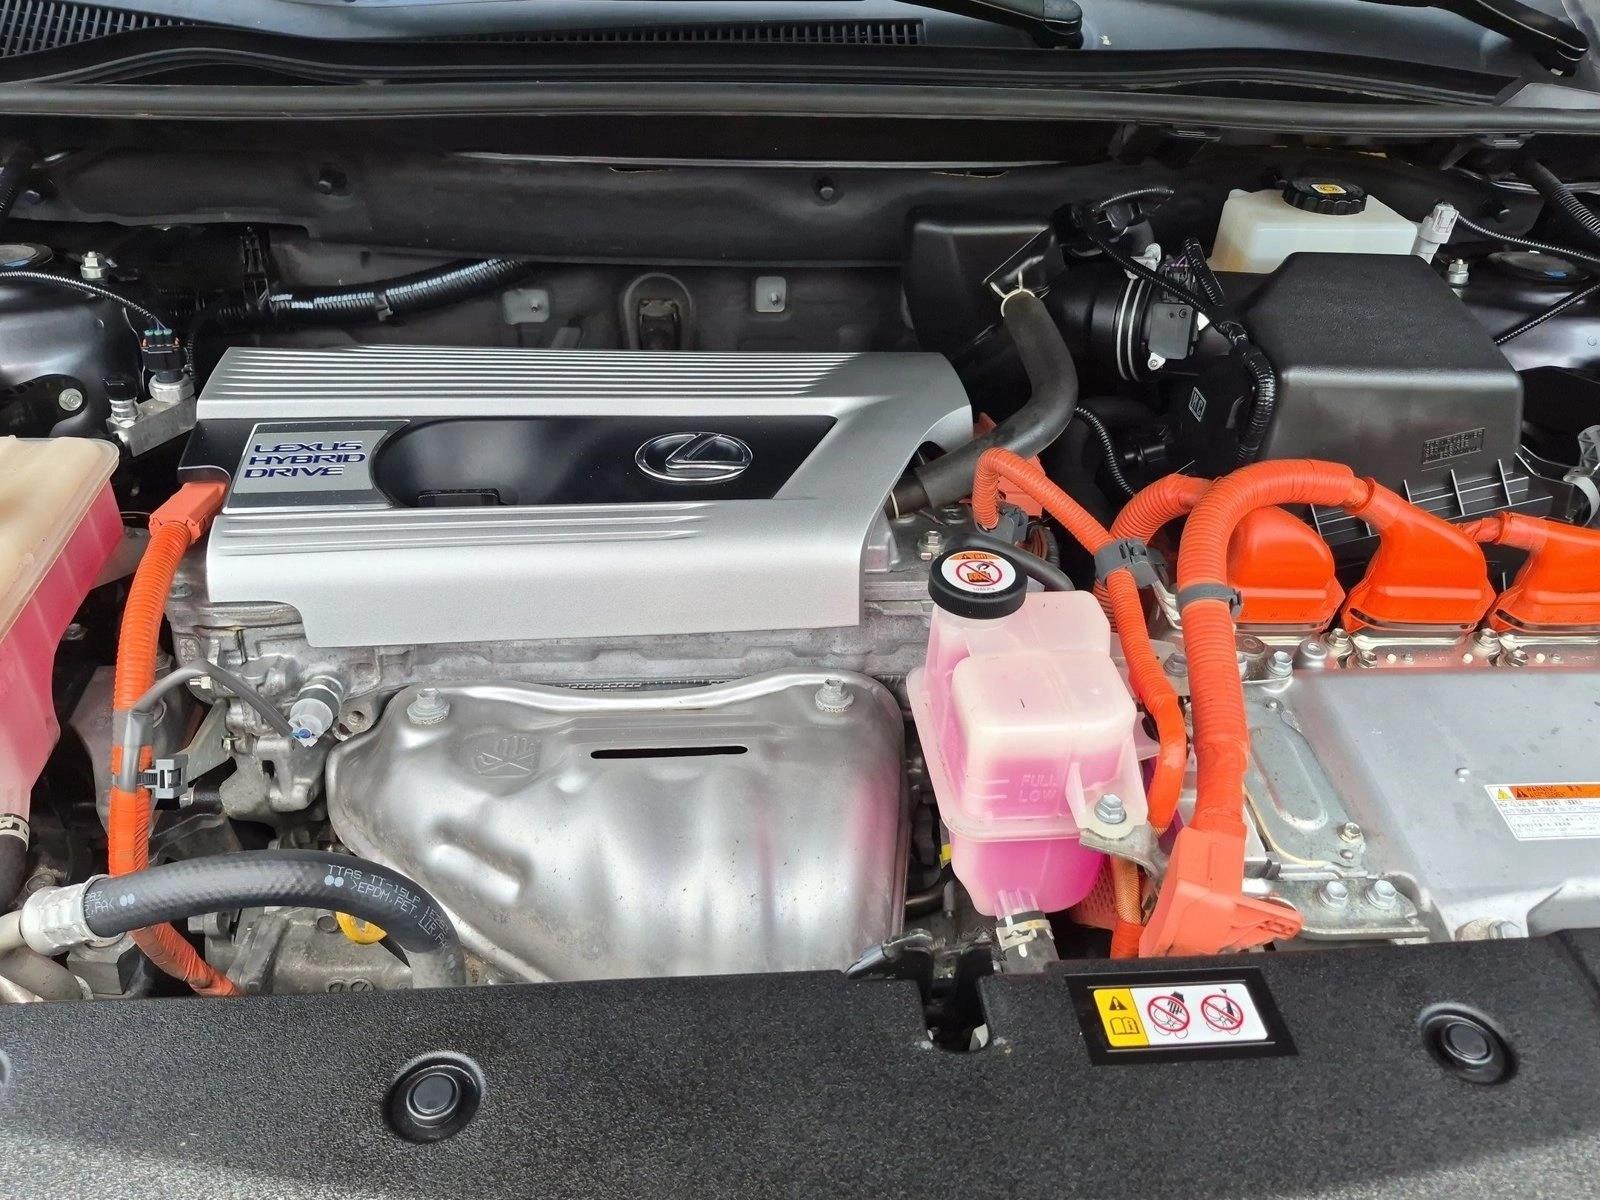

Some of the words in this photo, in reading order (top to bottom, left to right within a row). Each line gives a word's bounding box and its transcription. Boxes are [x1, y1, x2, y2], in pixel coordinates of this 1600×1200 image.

[254, 441, 363, 453] LEXUS
[249, 453, 366, 466] HYBRID
[244, 465, 345, 478] DRIVE
[1020, 774, 1057, 788] FULL
[1019, 789, 1057, 802] LOW
[327, 864, 363, 880] TTAS
